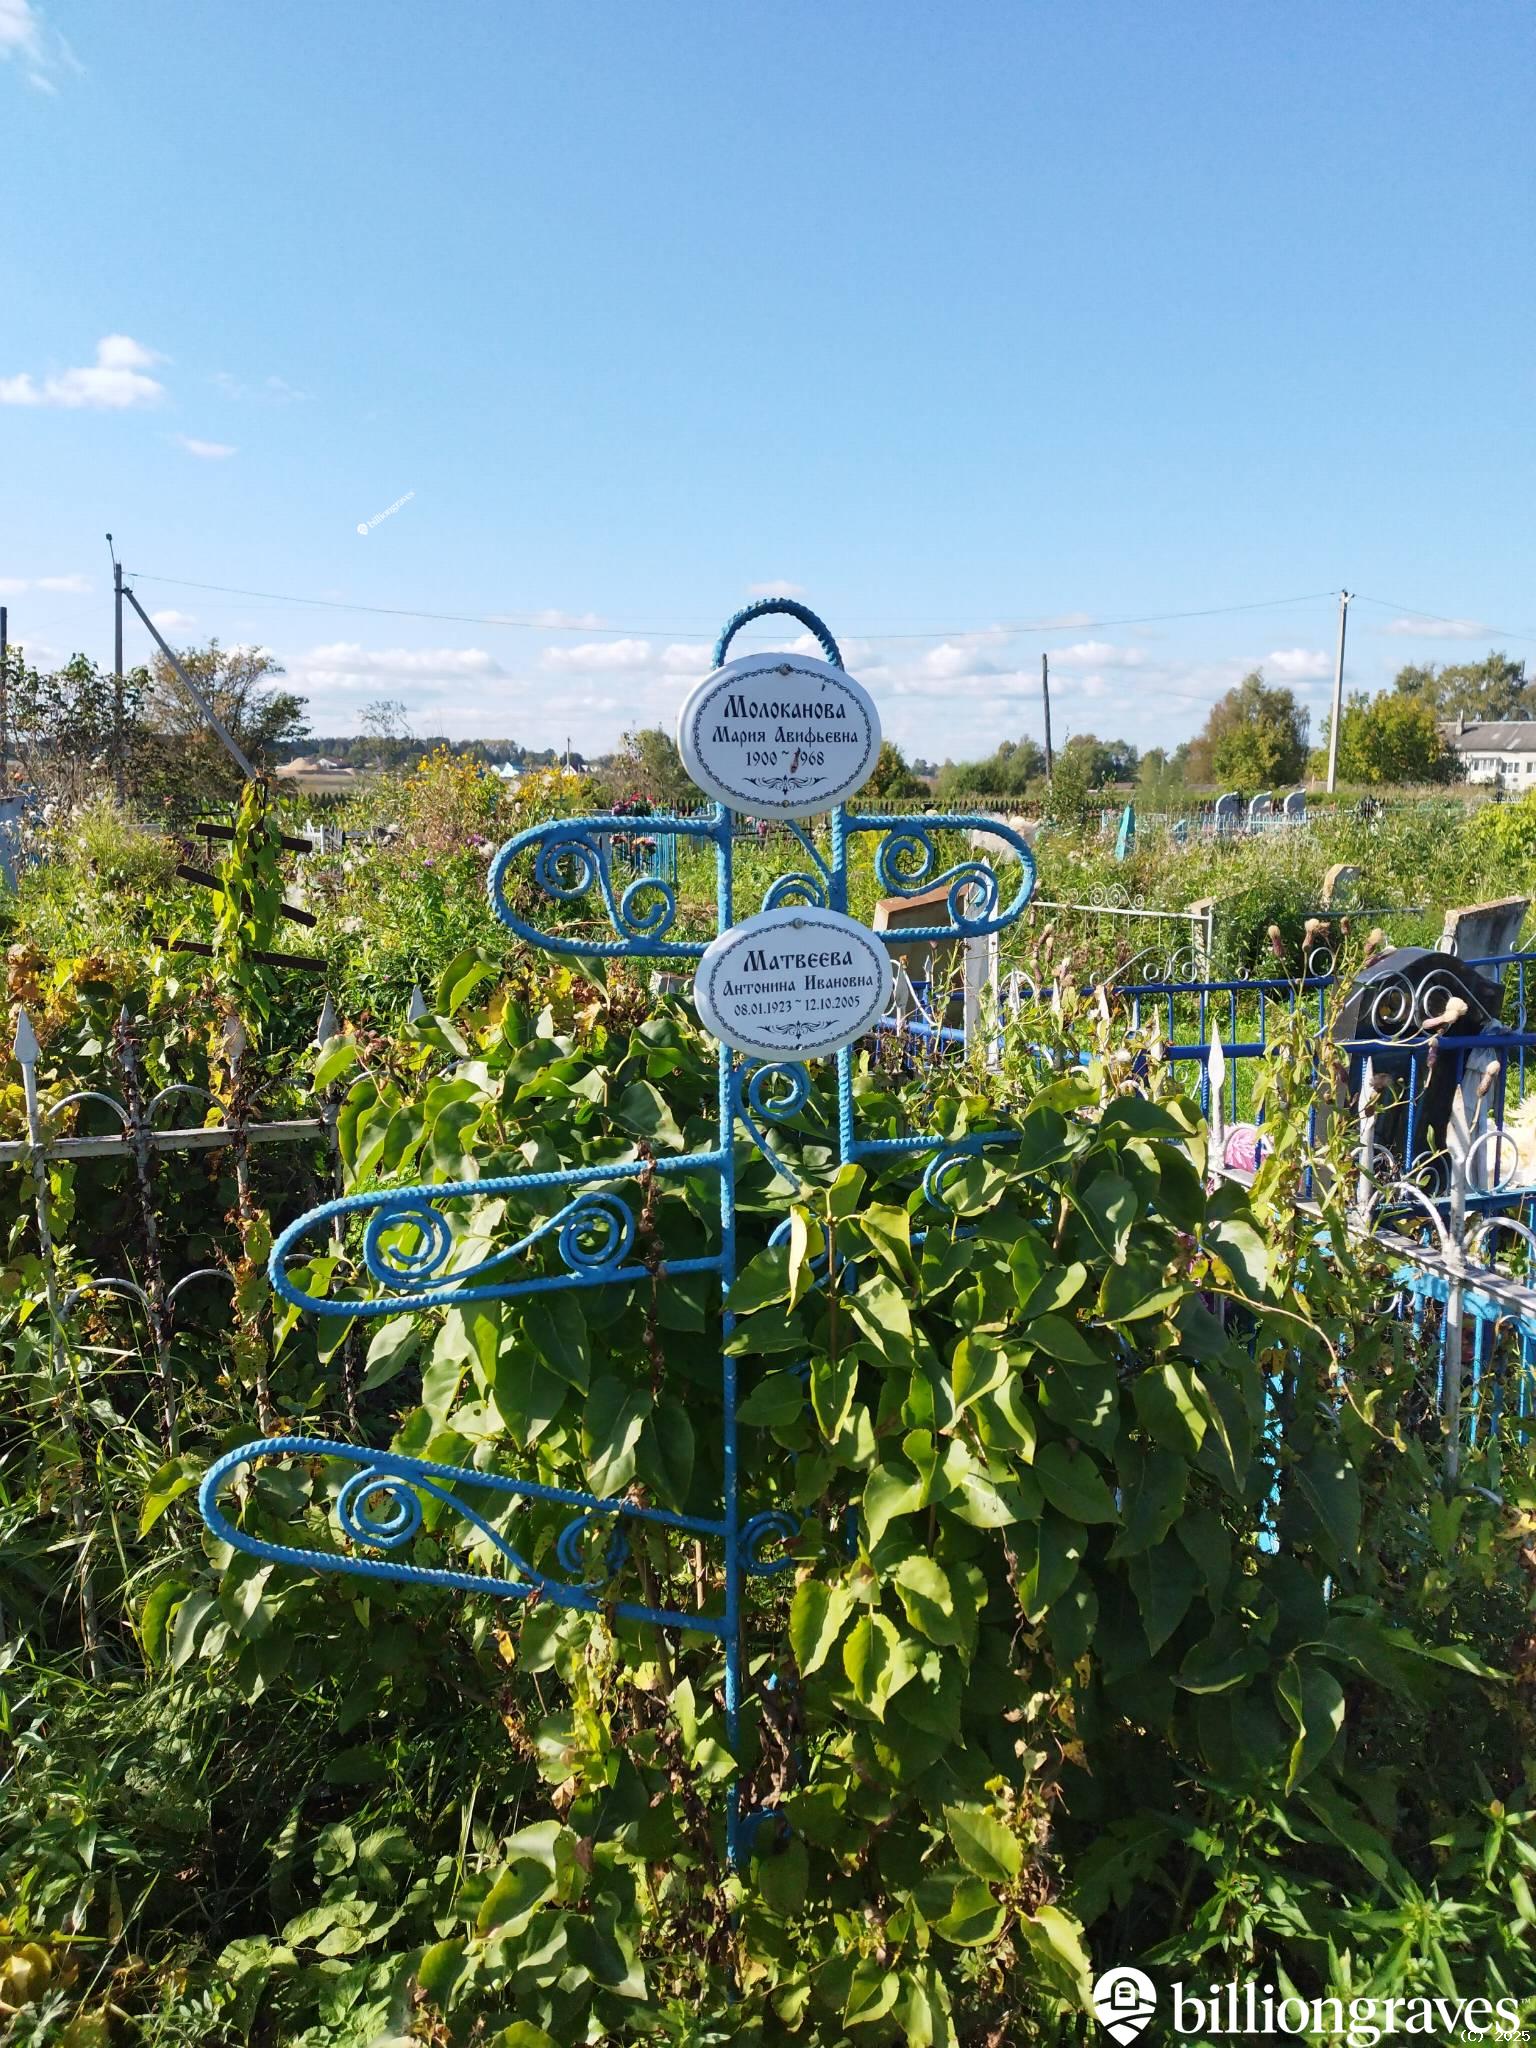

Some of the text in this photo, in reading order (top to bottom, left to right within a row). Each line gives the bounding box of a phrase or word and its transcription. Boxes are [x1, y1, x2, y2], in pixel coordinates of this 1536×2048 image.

[724, 695, 846, 719] Молоканова
[712, 726, 858, 748] Мария Авифьевна
[746, 751, 778, 766] 1900
[743, 950, 853, 972] Матвеева
[723, 975, 873, 996] Антонина Ивановна
[734, 1000, 792, 1017] 08.01.1923
[805, 996, 860, 1011] 12.10.2005
